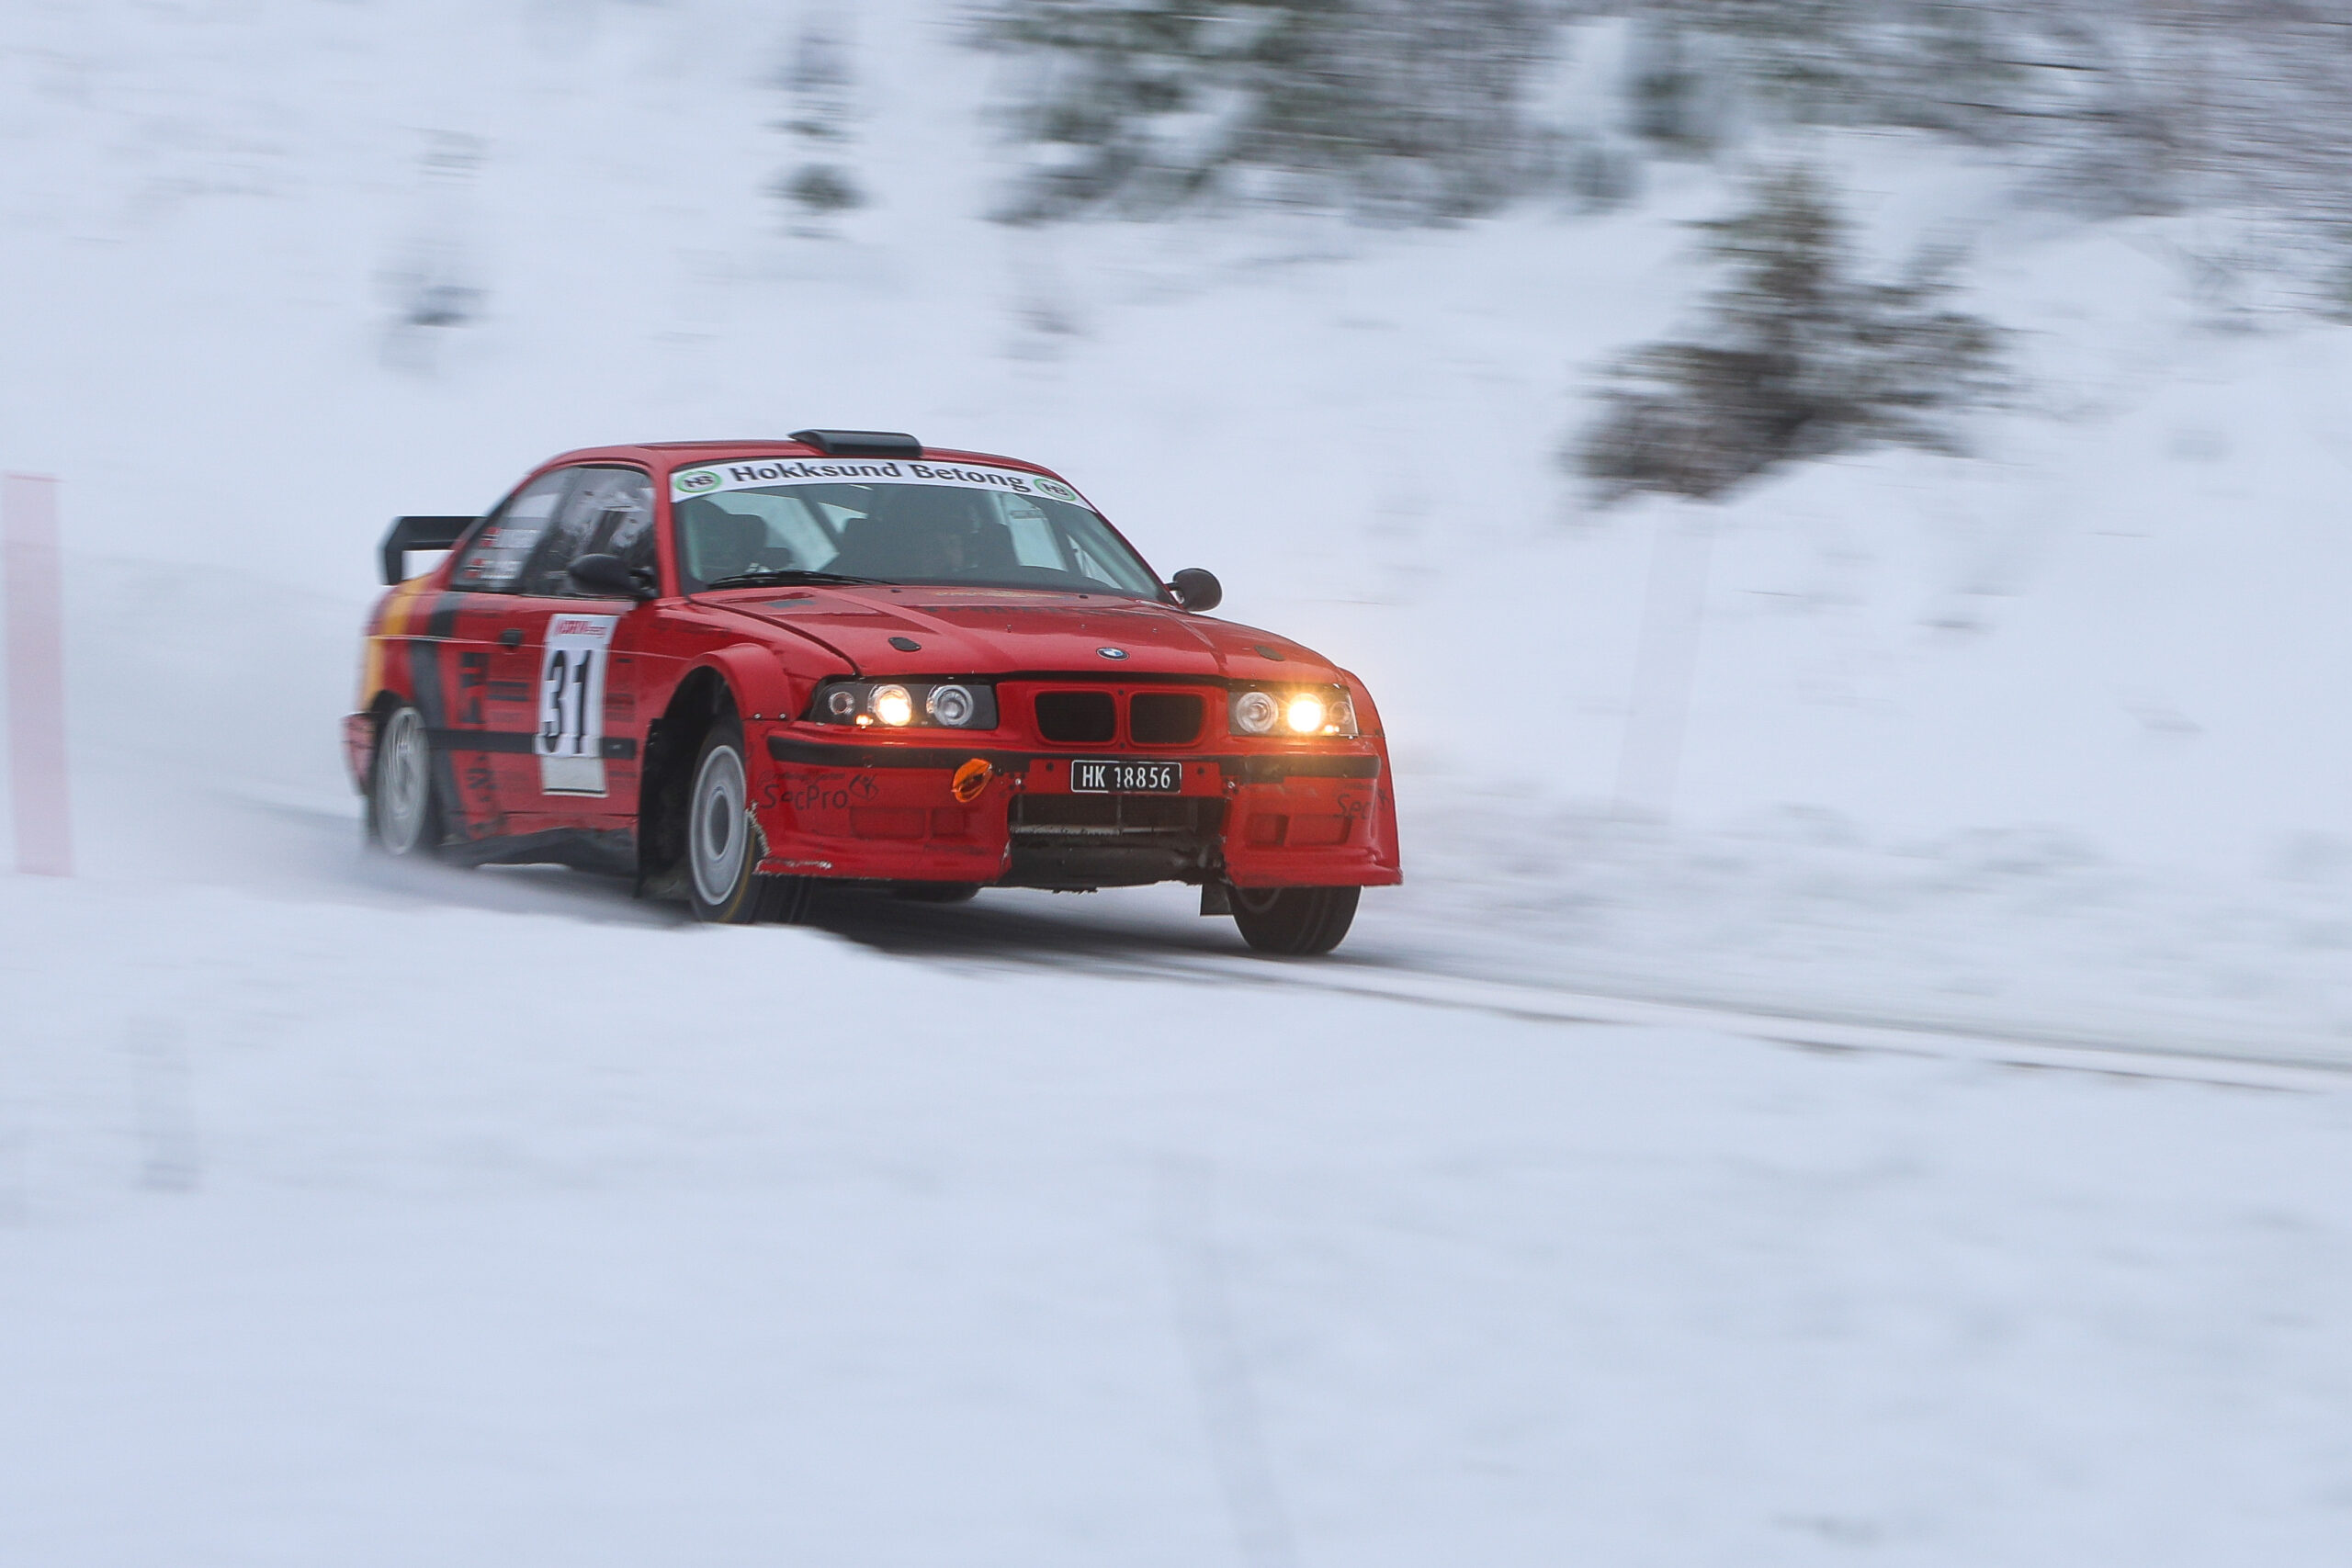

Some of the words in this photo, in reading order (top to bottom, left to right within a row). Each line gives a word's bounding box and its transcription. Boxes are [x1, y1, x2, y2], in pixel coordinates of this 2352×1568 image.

[729, 461, 902, 482] Hokksund
[910, 464, 1031, 492] Betong
[542, 649, 593, 755] 31
[1081, 766, 1105, 788] HK
[1114, 766, 1171, 789] 18856
